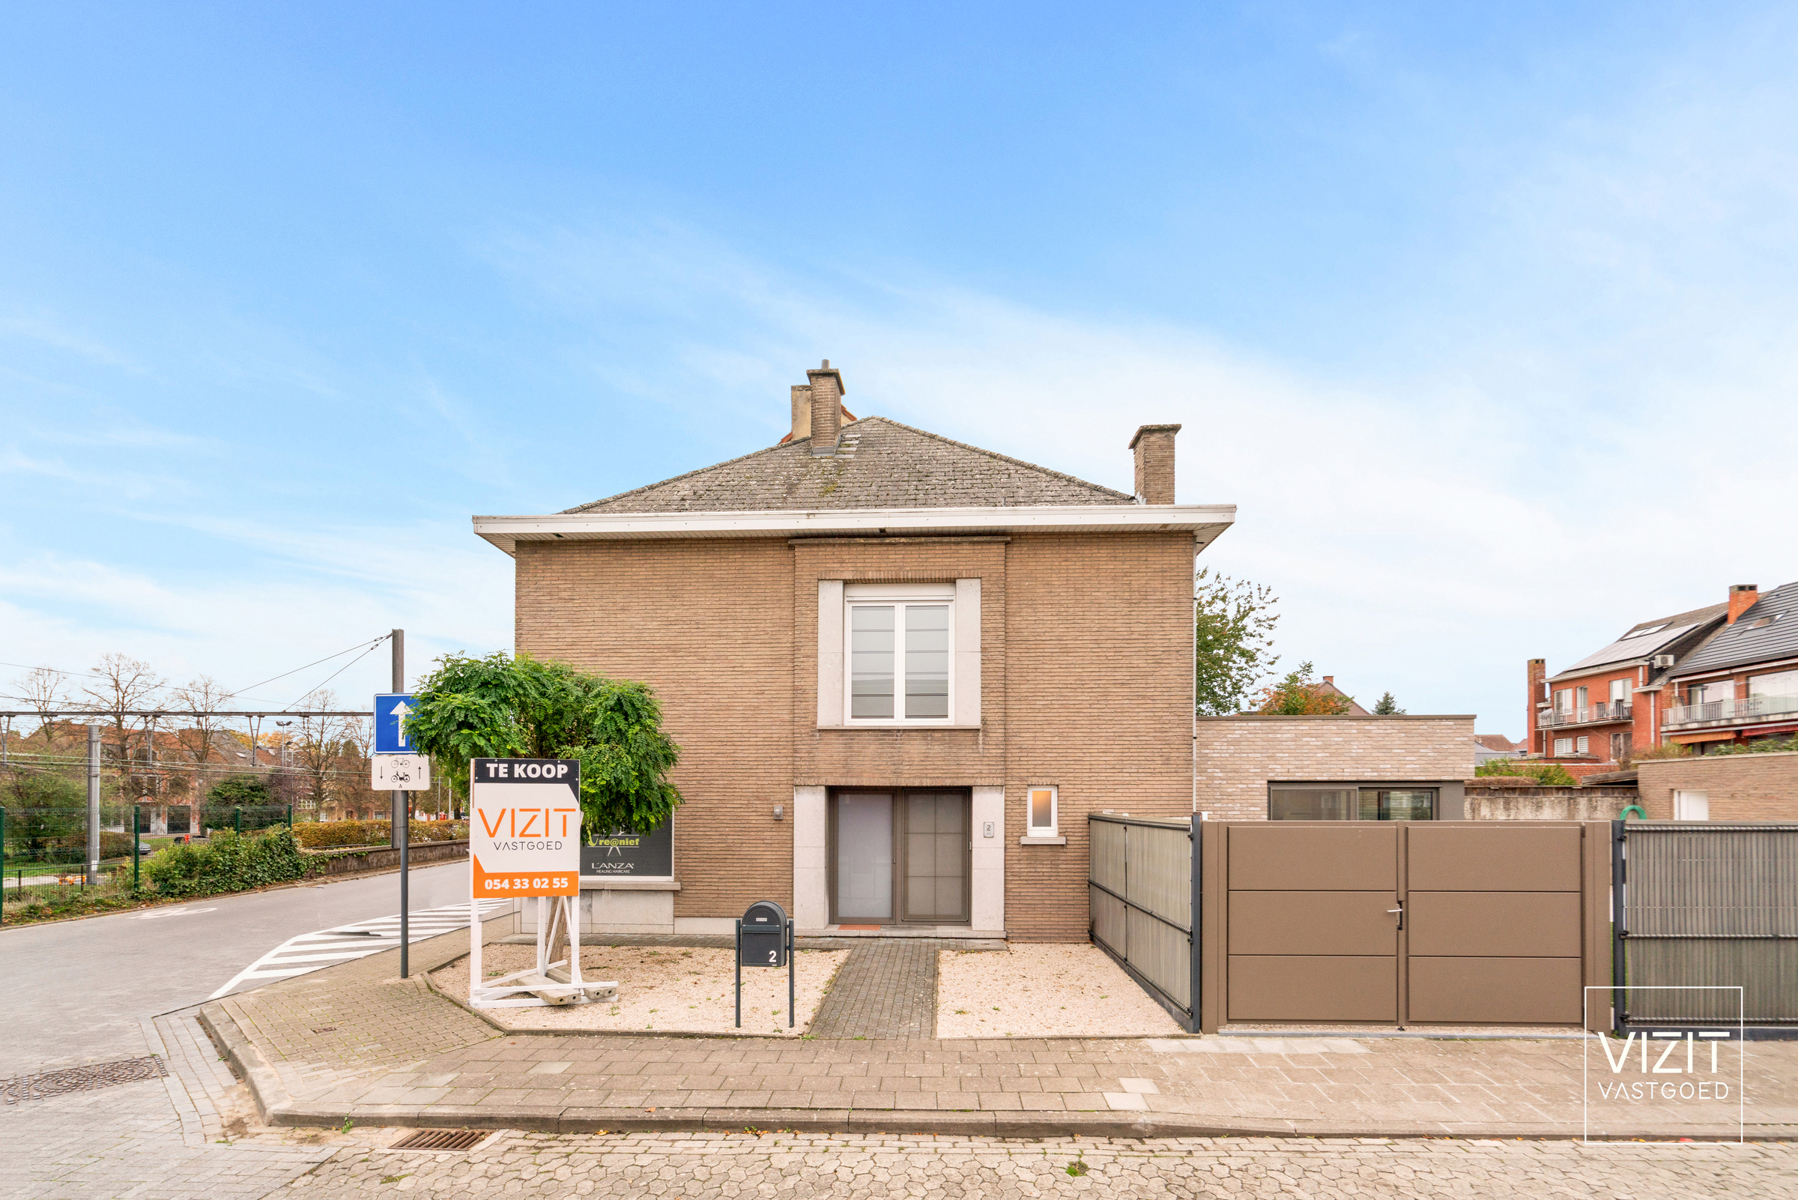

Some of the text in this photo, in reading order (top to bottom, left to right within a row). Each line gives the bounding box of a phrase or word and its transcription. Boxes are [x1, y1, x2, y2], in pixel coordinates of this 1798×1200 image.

[486, 763, 568, 779] TE KOOP
[477, 808, 576, 838] VIZIT
[986, 824, 992, 832] 2
[493, 841, 562, 851] VASTGOED
[484, 878, 569, 890] 054 33 02 55
[768, 950, 777, 963] 2
